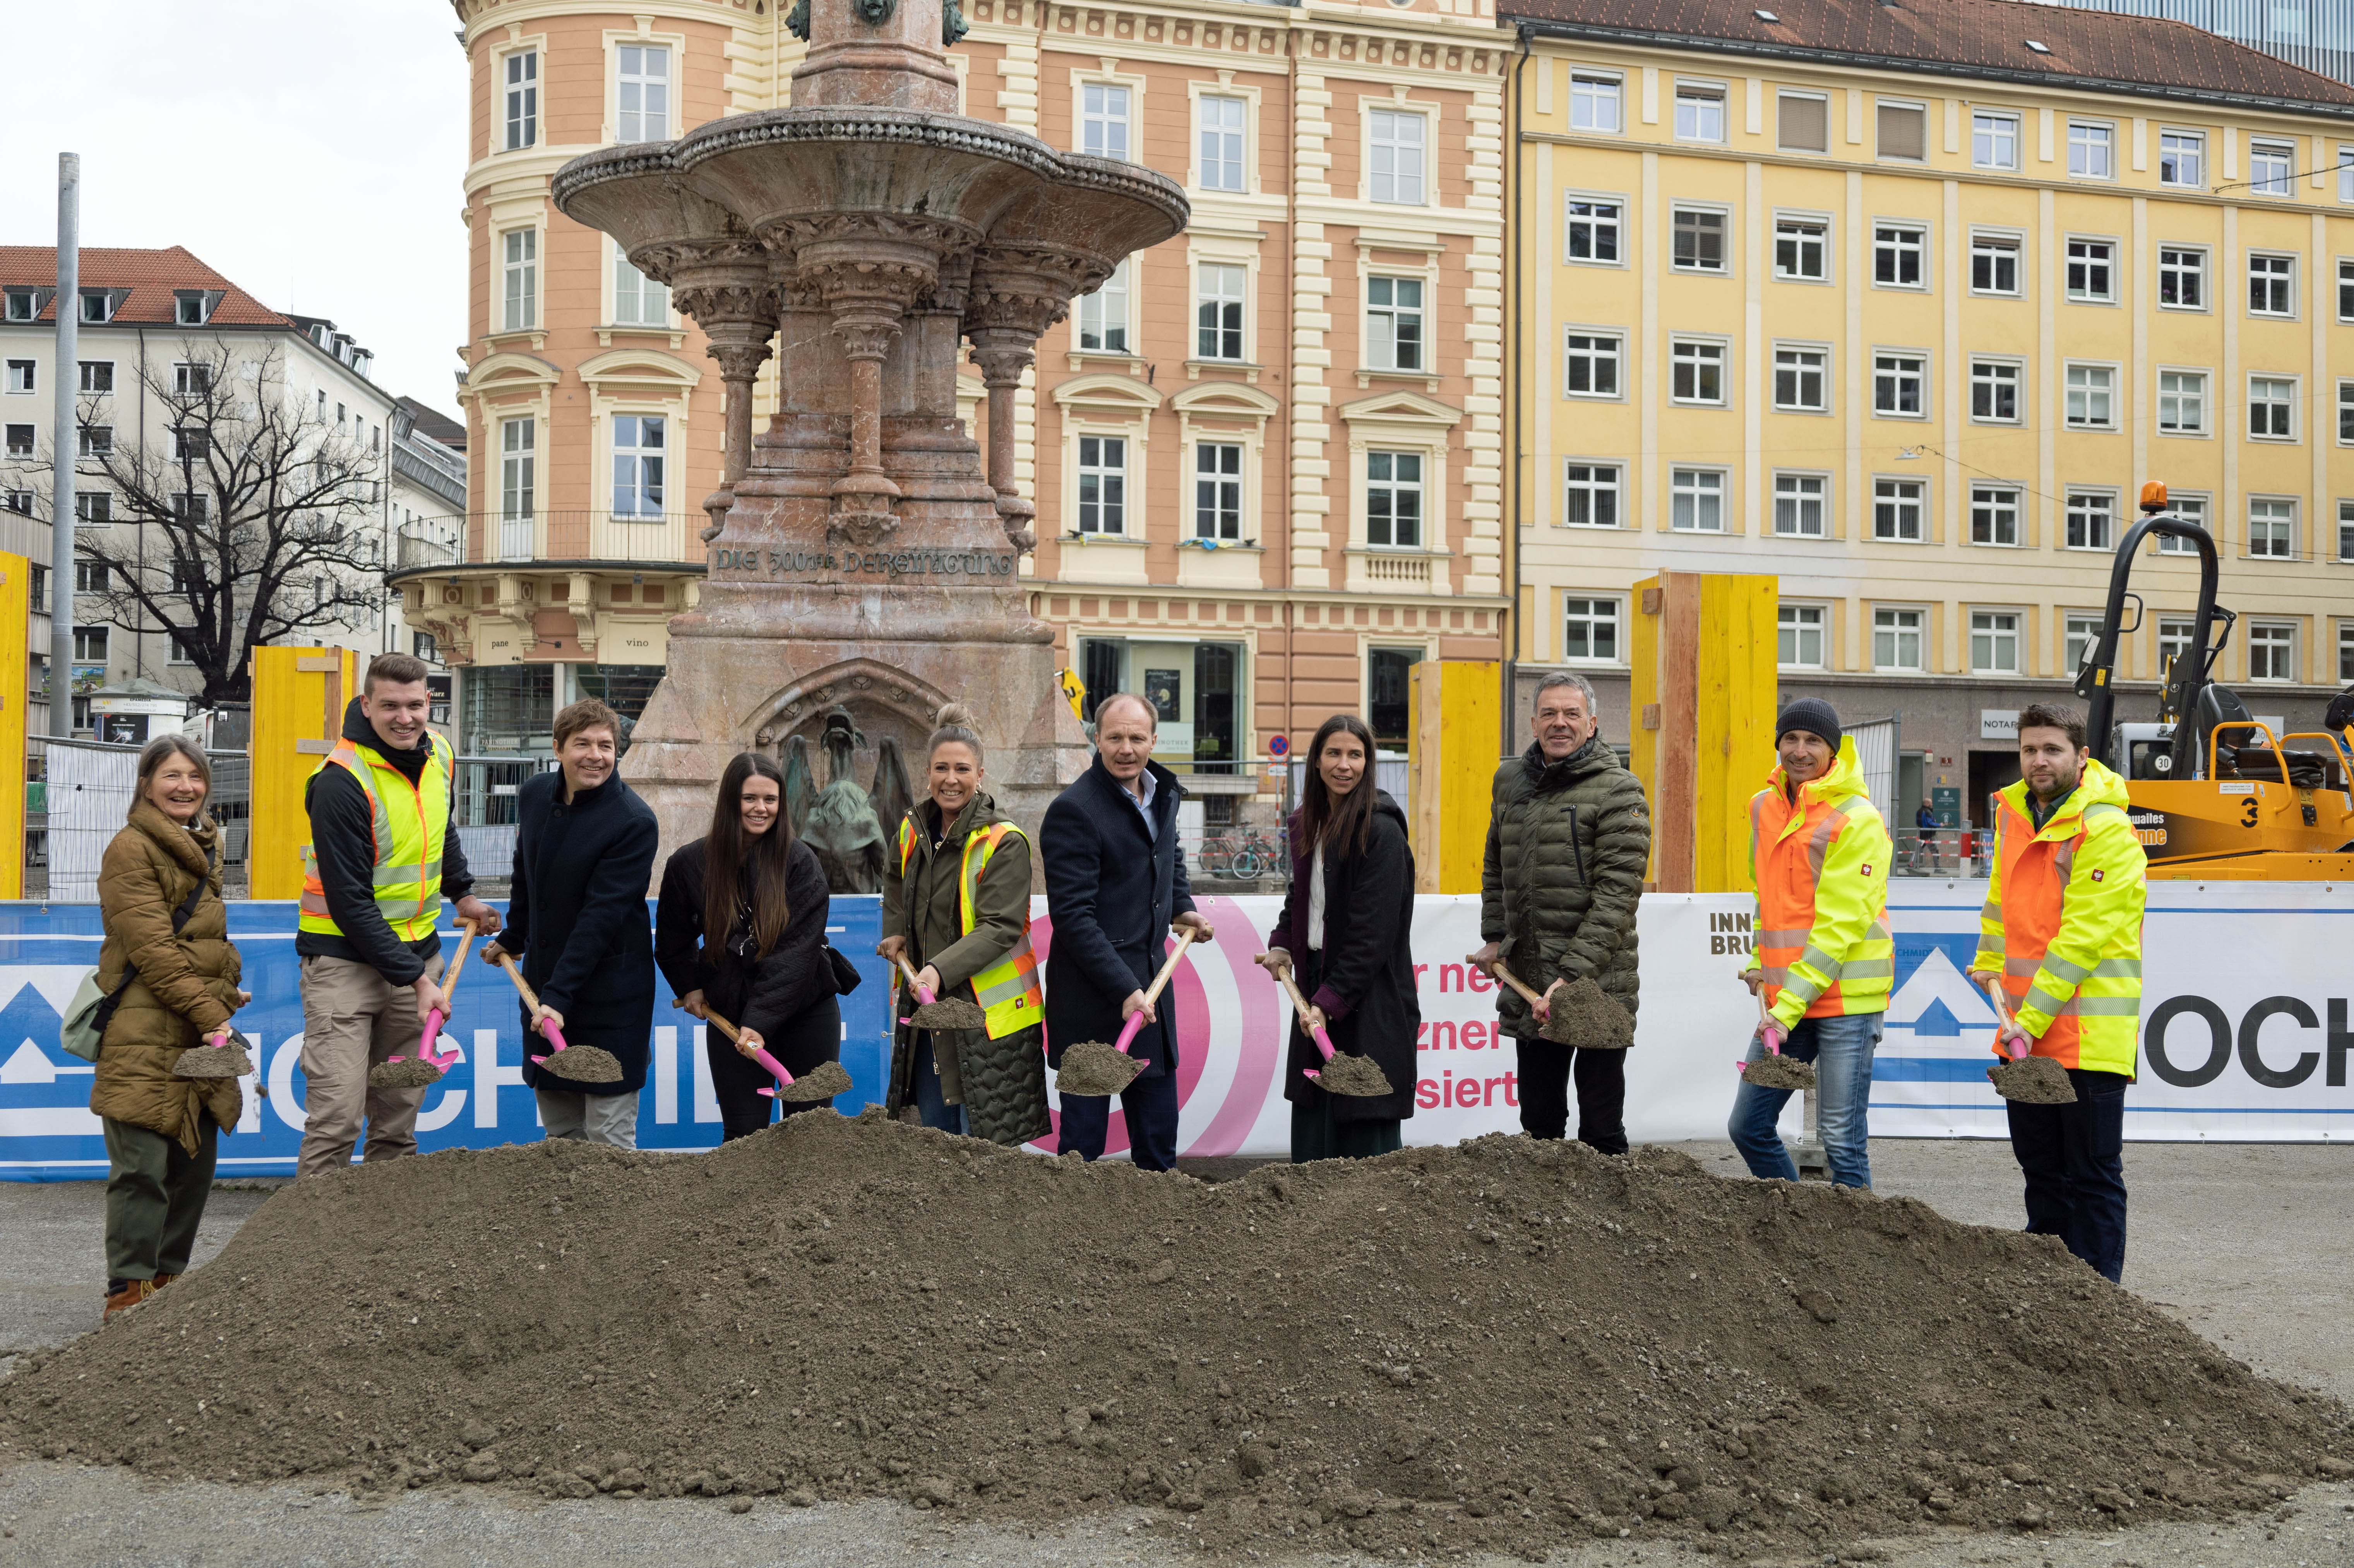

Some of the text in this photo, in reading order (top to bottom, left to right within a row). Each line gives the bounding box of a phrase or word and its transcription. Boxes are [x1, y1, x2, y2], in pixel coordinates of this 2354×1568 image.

[717, 548, 759, 570] DIE
[492, 641, 509, 649] pane
[626, 638, 649, 646] vino
[2254, 730, 2280, 739] tioen
[2158, 758, 2169, 768] 30
[2127, 813, 2164, 824] waites
[2241, 797, 2258, 828] 3
[2136, 829, 2167, 845] nne
[1710, 913, 1755, 932] INN
[1711, 935, 1754, 955] BRU
[1439, 963, 1504, 993] ne
[1417, 1020, 1501, 1050] zner
[1415, 1070, 1518, 1109] siert
